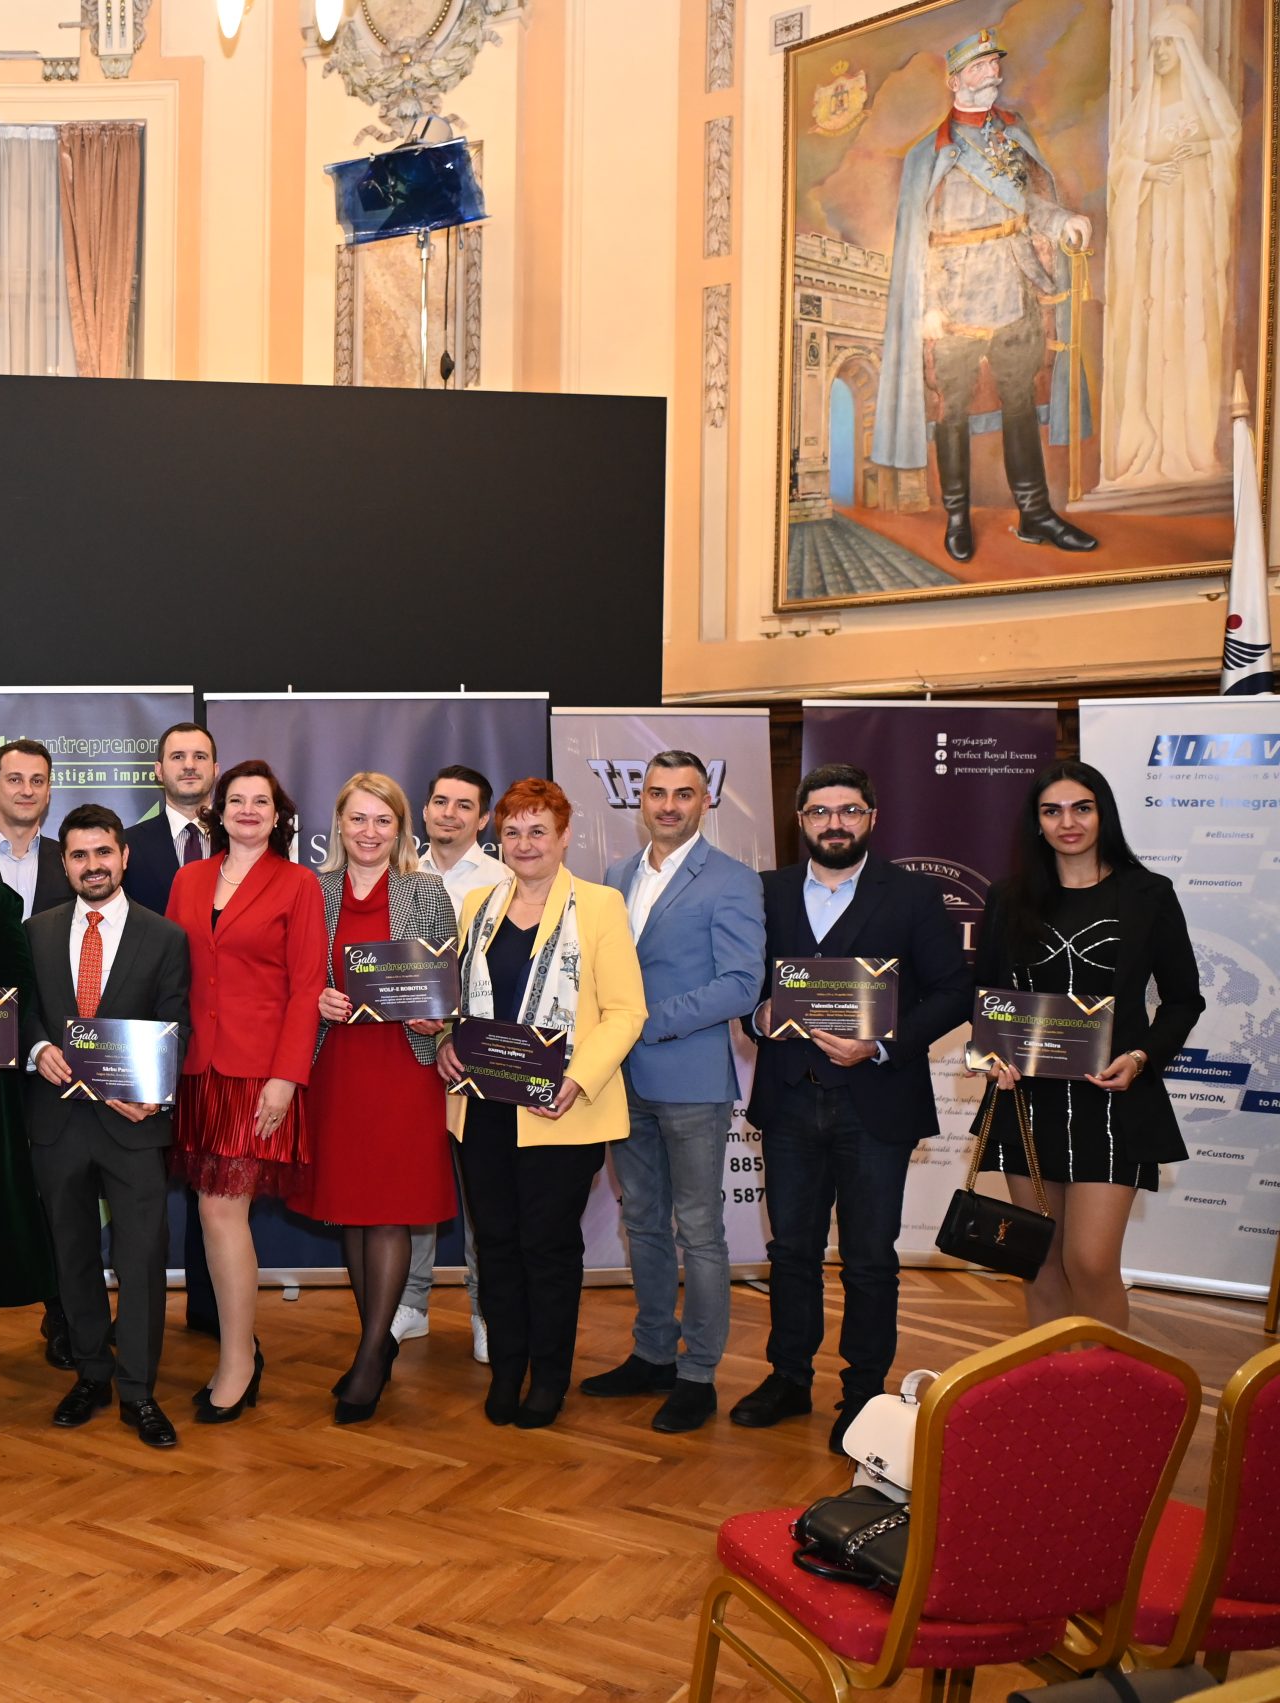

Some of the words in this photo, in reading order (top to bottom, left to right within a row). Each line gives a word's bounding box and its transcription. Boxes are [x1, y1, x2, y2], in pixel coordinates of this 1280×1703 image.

[953, 751, 981, 759] Perfect
[984, 750, 1008, 761] Royal
[1010, 751, 1037, 760] Events
[49, 768, 107, 786] âștigăm
[955, 765, 1035, 775] petreceriperfecte.ro
[1205, 831, 1255, 839] #eBusiness
[921, 863, 961, 878] EVENTS
[1188, 879, 1242, 887] #innovation
[350, 950, 378, 971] Gala
[779, 965, 810, 986] Gala
[981, 996, 1016, 1016] Gala
[70, 1025, 99, 1046] Gala
[526, 1082, 556, 1103] Gala
[1189, 1093, 1226, 1104] VISION,
[1259, 1099, 1270, 1107] to
[1196, 1149, 1246, 1161] #eCustoms
[730, 1157, 765, 1173] 885
[733, 1188, 765, 1203] 587
[1184, 1195, 1228, 1206] #research
